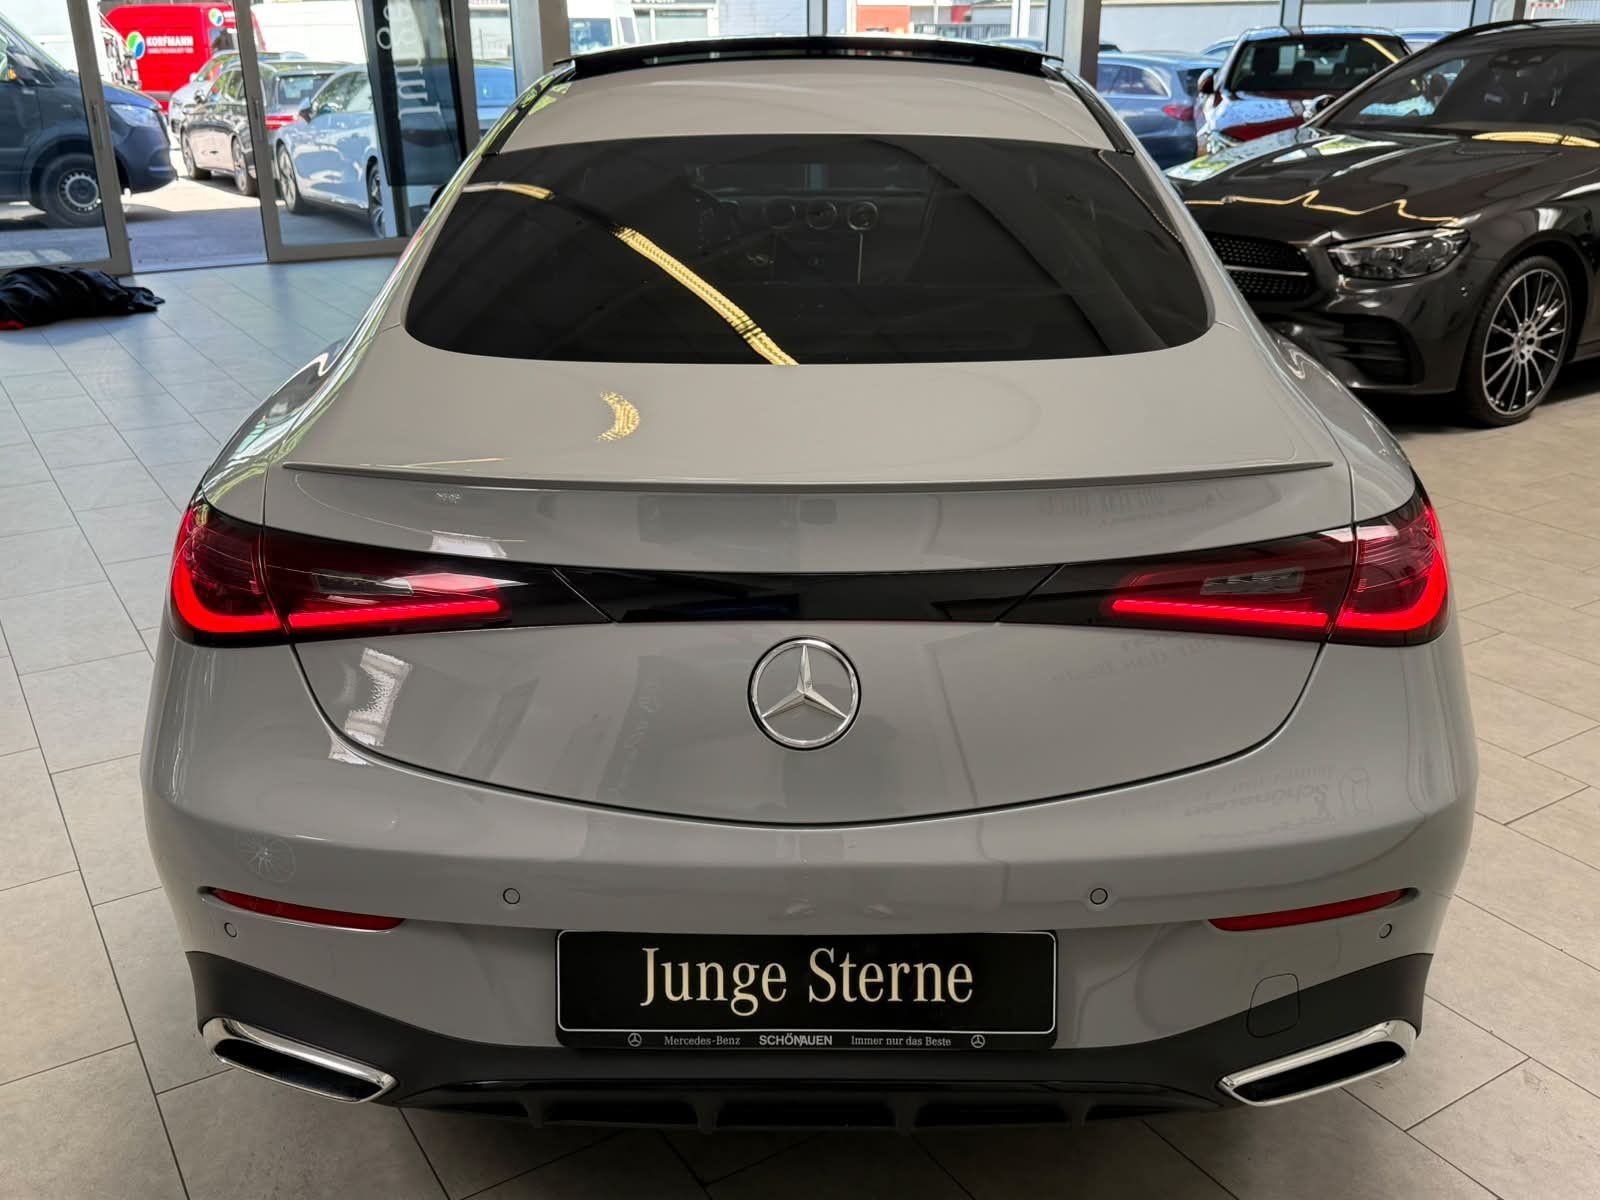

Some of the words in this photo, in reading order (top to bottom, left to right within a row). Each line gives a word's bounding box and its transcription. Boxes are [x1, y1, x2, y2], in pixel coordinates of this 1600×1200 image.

[640, 947, 787, 1017] Junge
[808, 947, 973, 1003] Sterne
[664, 1035, 740, 1046] Mercedes-Benz
[759, 1032, 833, 1047] SCHÖNAUEN
[851, 1035, 883, 1046] Immer
[886, 1037, 904, 1046] nur
[906, 1035, 923, 1047] das
[925, 1036, 952, 1047] Beste
